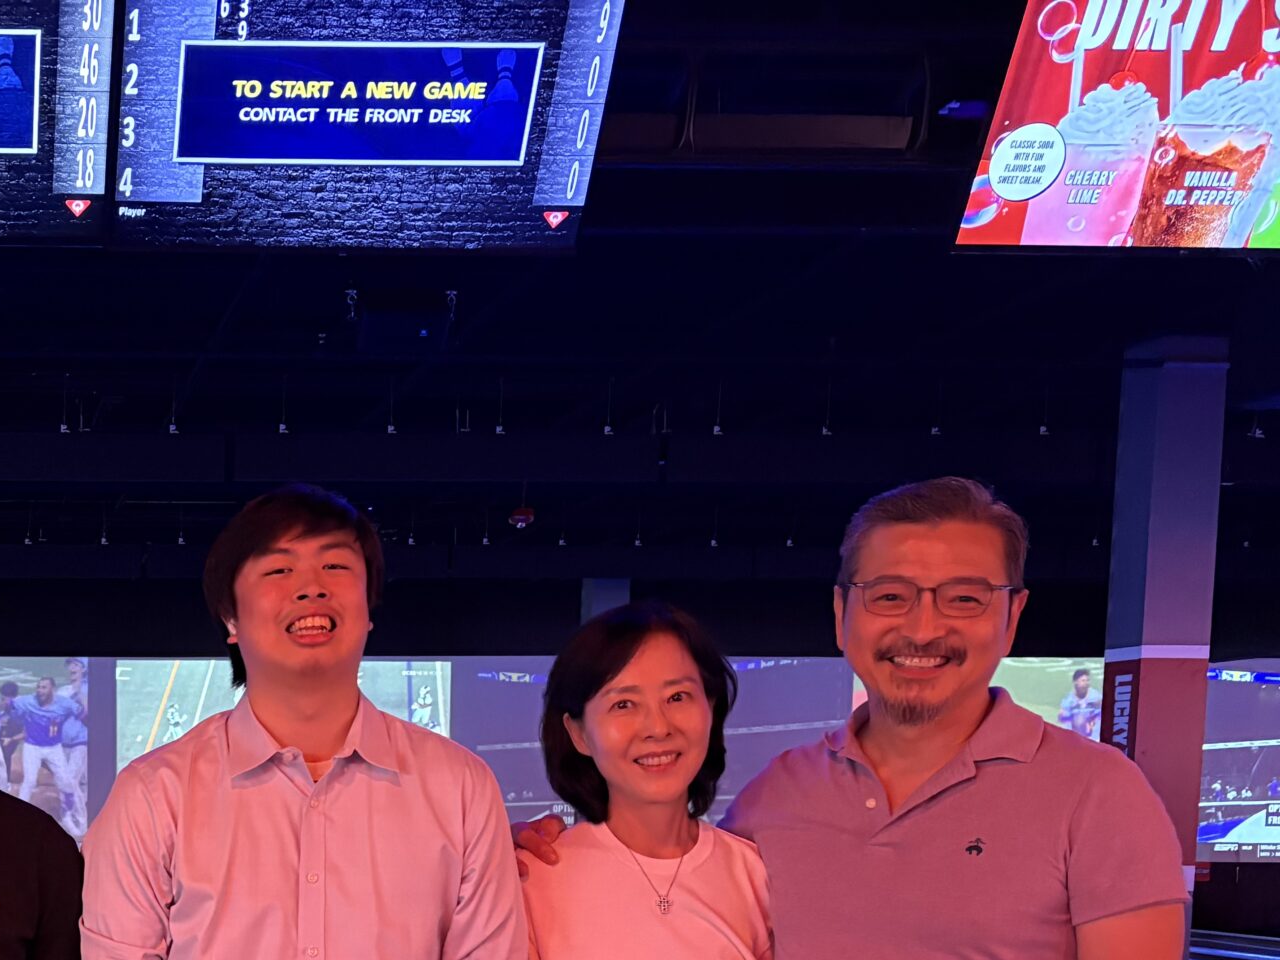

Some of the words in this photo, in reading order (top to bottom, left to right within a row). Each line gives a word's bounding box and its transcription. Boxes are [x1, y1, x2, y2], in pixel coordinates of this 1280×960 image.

[128, 9, 140, 41] 1
[238, 20, 247, 41] 9
[596, 0, 610, 43] 9
[80, 43, 98, 85] 46
[125, 63, 138, 95] 2
[587, 56, 600, 97] 0
[232, 80, 262, 98] TO
[270, 80, 333, 99] START
[341, 81, 357, 99] A
[366, 82, 415, 99] NEW
[423, 82, 487, 100] GAME
[77, 97, 96, 137] 20
[239, 107, 319, 122] CONTACT
[327, 108, 359, 122] THE
[365, 109, 423, 123] FRONT
[429, 109, 472, 123] DESK
[122, 116, 135, 147] 3
[577, 109, 589, 149] 0
[1010, 140, 1036, 149] CLASSIC
[1037, 141, 1055, 149] SODA
[76, 149, 94, 188] 18
[1004, 164, 1031, 173] FLAVORS
[1032, 164, 1046, 173] AND
[1014, 153, 1029, 161] WITH
[1031, 153, 1044, 161] FUN
[119, 168, 132, 196] 4
[567, 160, 579, 199] 0
[997, 176, 1019, 184] SWEET
[1064, 170, 1117, 186] CHERRY
[1184, 171, 1238, 187] VANILLA
[1067, 189, 1102, 204] LIME
[1165, 189, 1187, 206] DR.
[1189, 190, 1244, 206] PEPPER
[119, 206, 146, 218] Player
[1113, 674, 1133, 746] LUCKY
